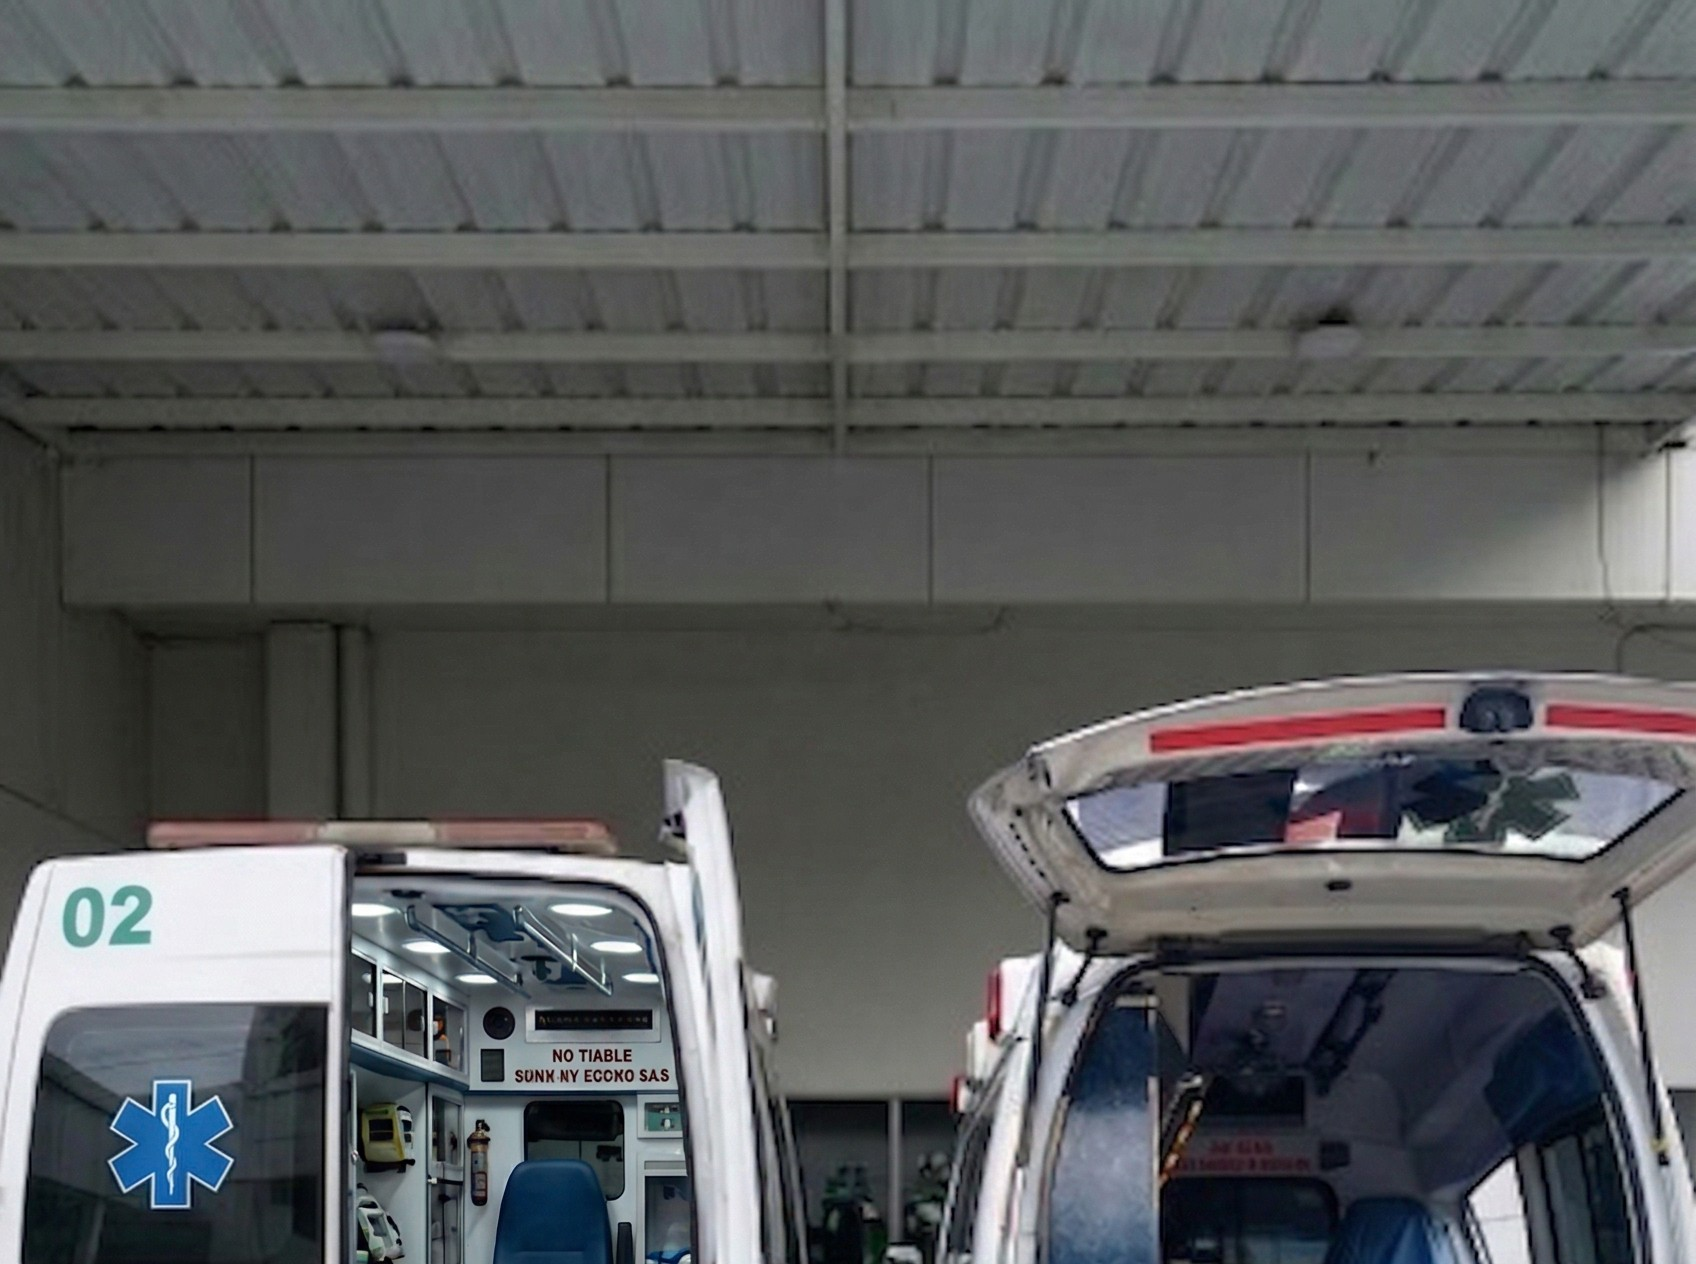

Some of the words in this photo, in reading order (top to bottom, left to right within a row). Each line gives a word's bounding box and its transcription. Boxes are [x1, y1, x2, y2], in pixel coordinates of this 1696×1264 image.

[62, 885, 152, 948] 02
[552, 1049, 574, 1063] NO
[578, 1049, 632, 1063] TIABLE
[639, 1068, 669, 1082] SAS
